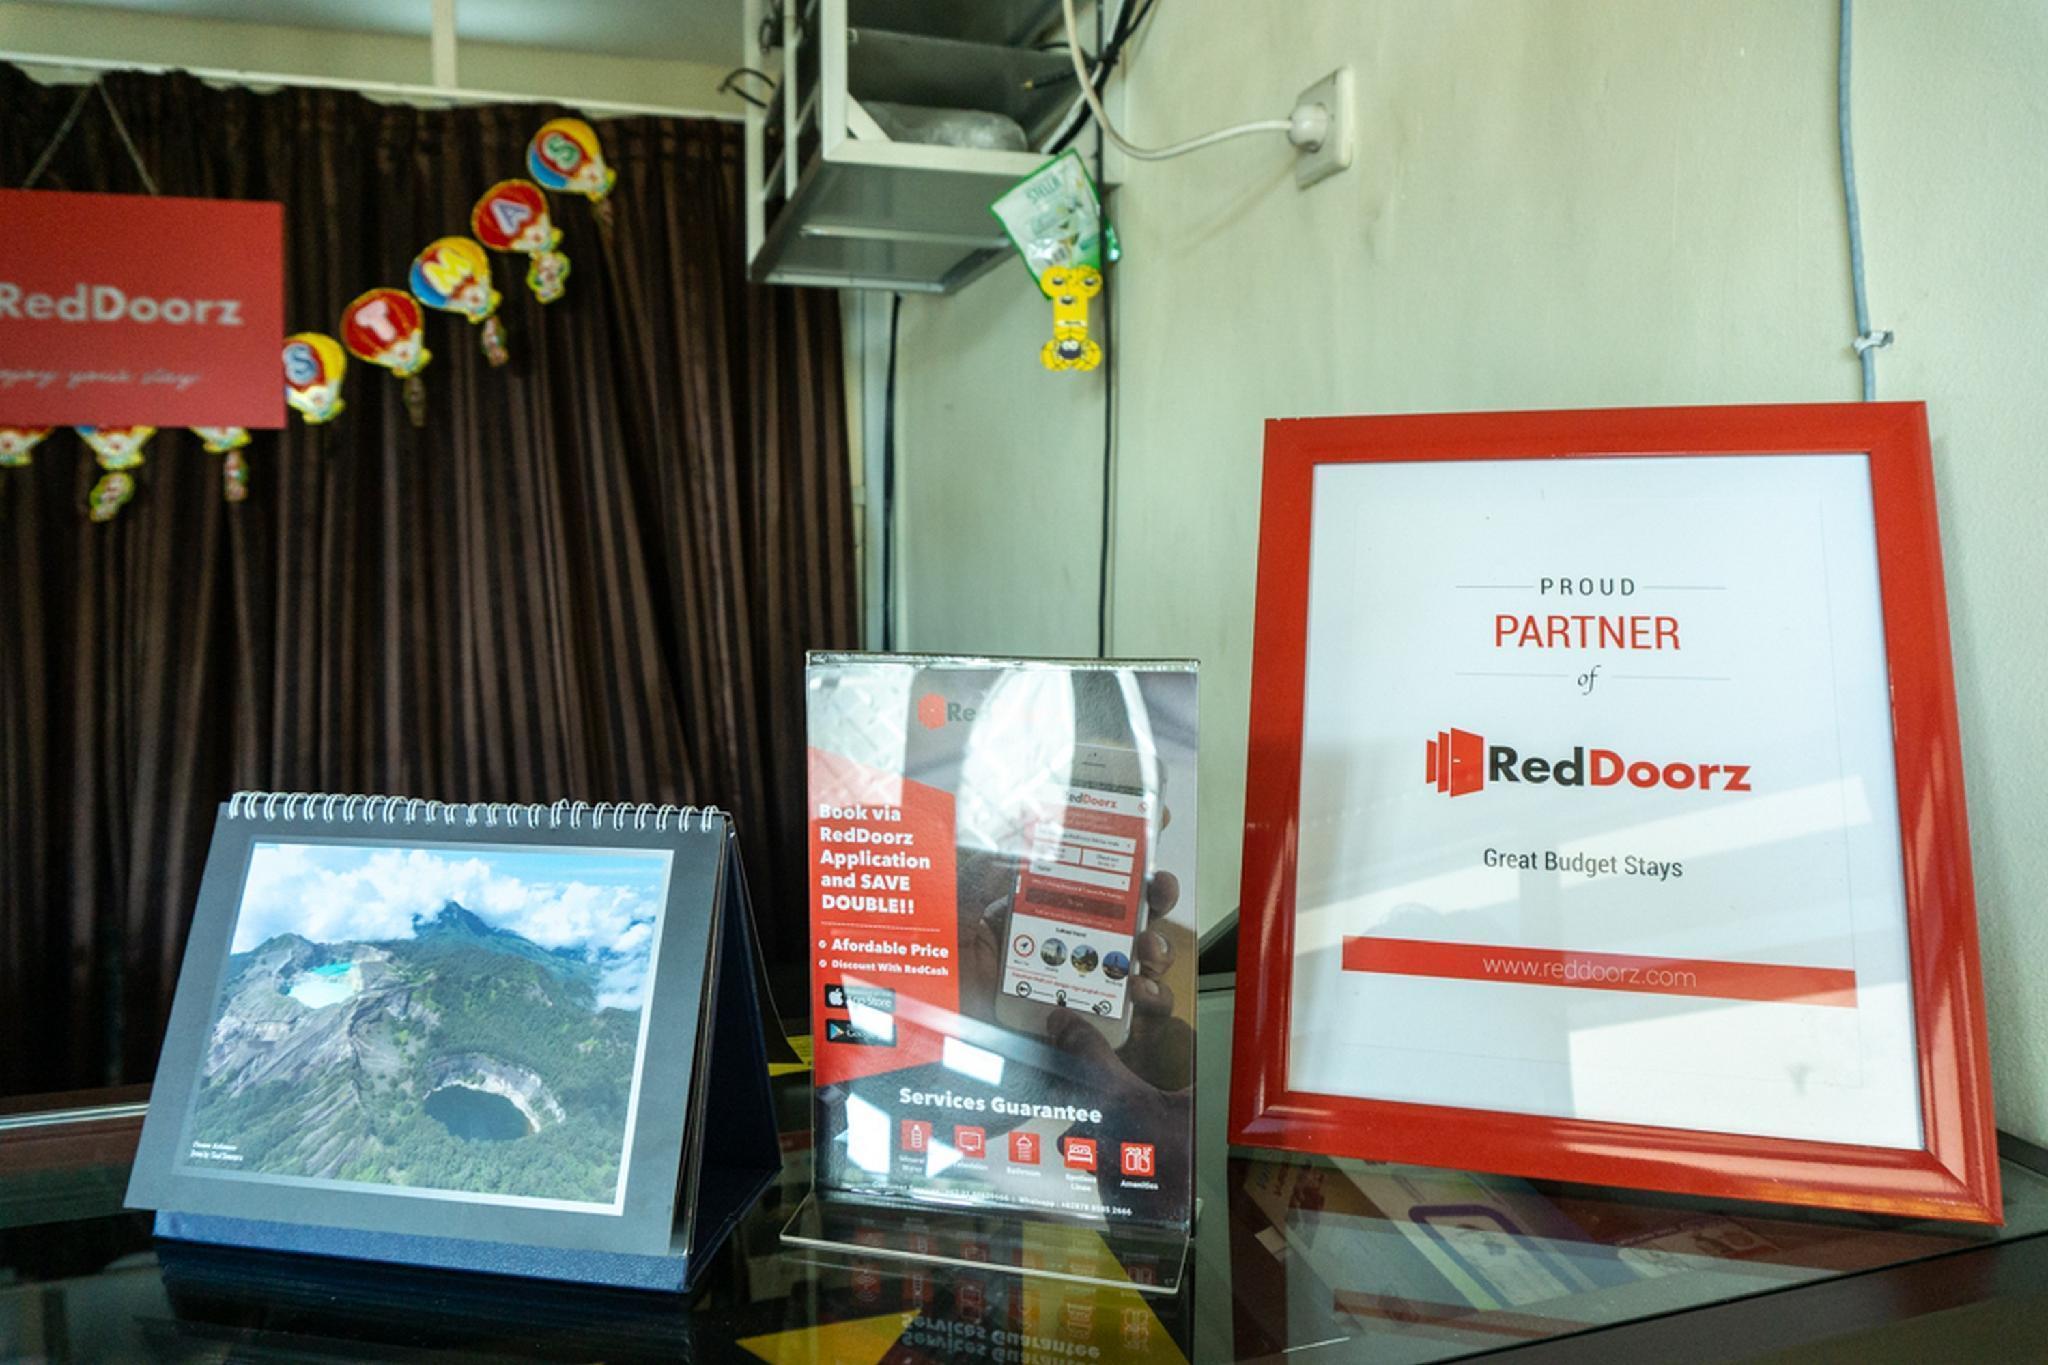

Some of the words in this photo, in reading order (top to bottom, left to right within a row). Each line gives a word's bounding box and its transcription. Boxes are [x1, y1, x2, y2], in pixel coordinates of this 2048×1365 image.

[0, 282, 244, 326] RedDoorz
[1540, 577, 1635, 596] PROUD
[1495, 614, 1681, 650] PARTNER
[1577, 664, 1601, 695] of
[1489, 746, 1752, 792] RedDoorz
[819, 803, 868, 820] Book
[872, 804, 901, 822] via
[820, 826, 914, 846] RedDoorz
[820, 848, 931, 870] Application
[1484, 848, 1538, 870] Great
[1545, 851, 1618, 878] Budget
[1624, 855, 1684, 881] Stays
[821, 872, 856, 889] and
[861, 873, 911, 891] SAVE
[822, 894, 914, 915] DOUBLE!!
[910, 943, 949, 959] Price
[831, 959, 877, 972] Discount
[904, 964, 949, 977] RedCash
[1482, 956, 1698, 988] www.reddoorz.com
[900, 1087, 986, 1112] Services
[990, 1096, 1103, 1124] Guarantee
